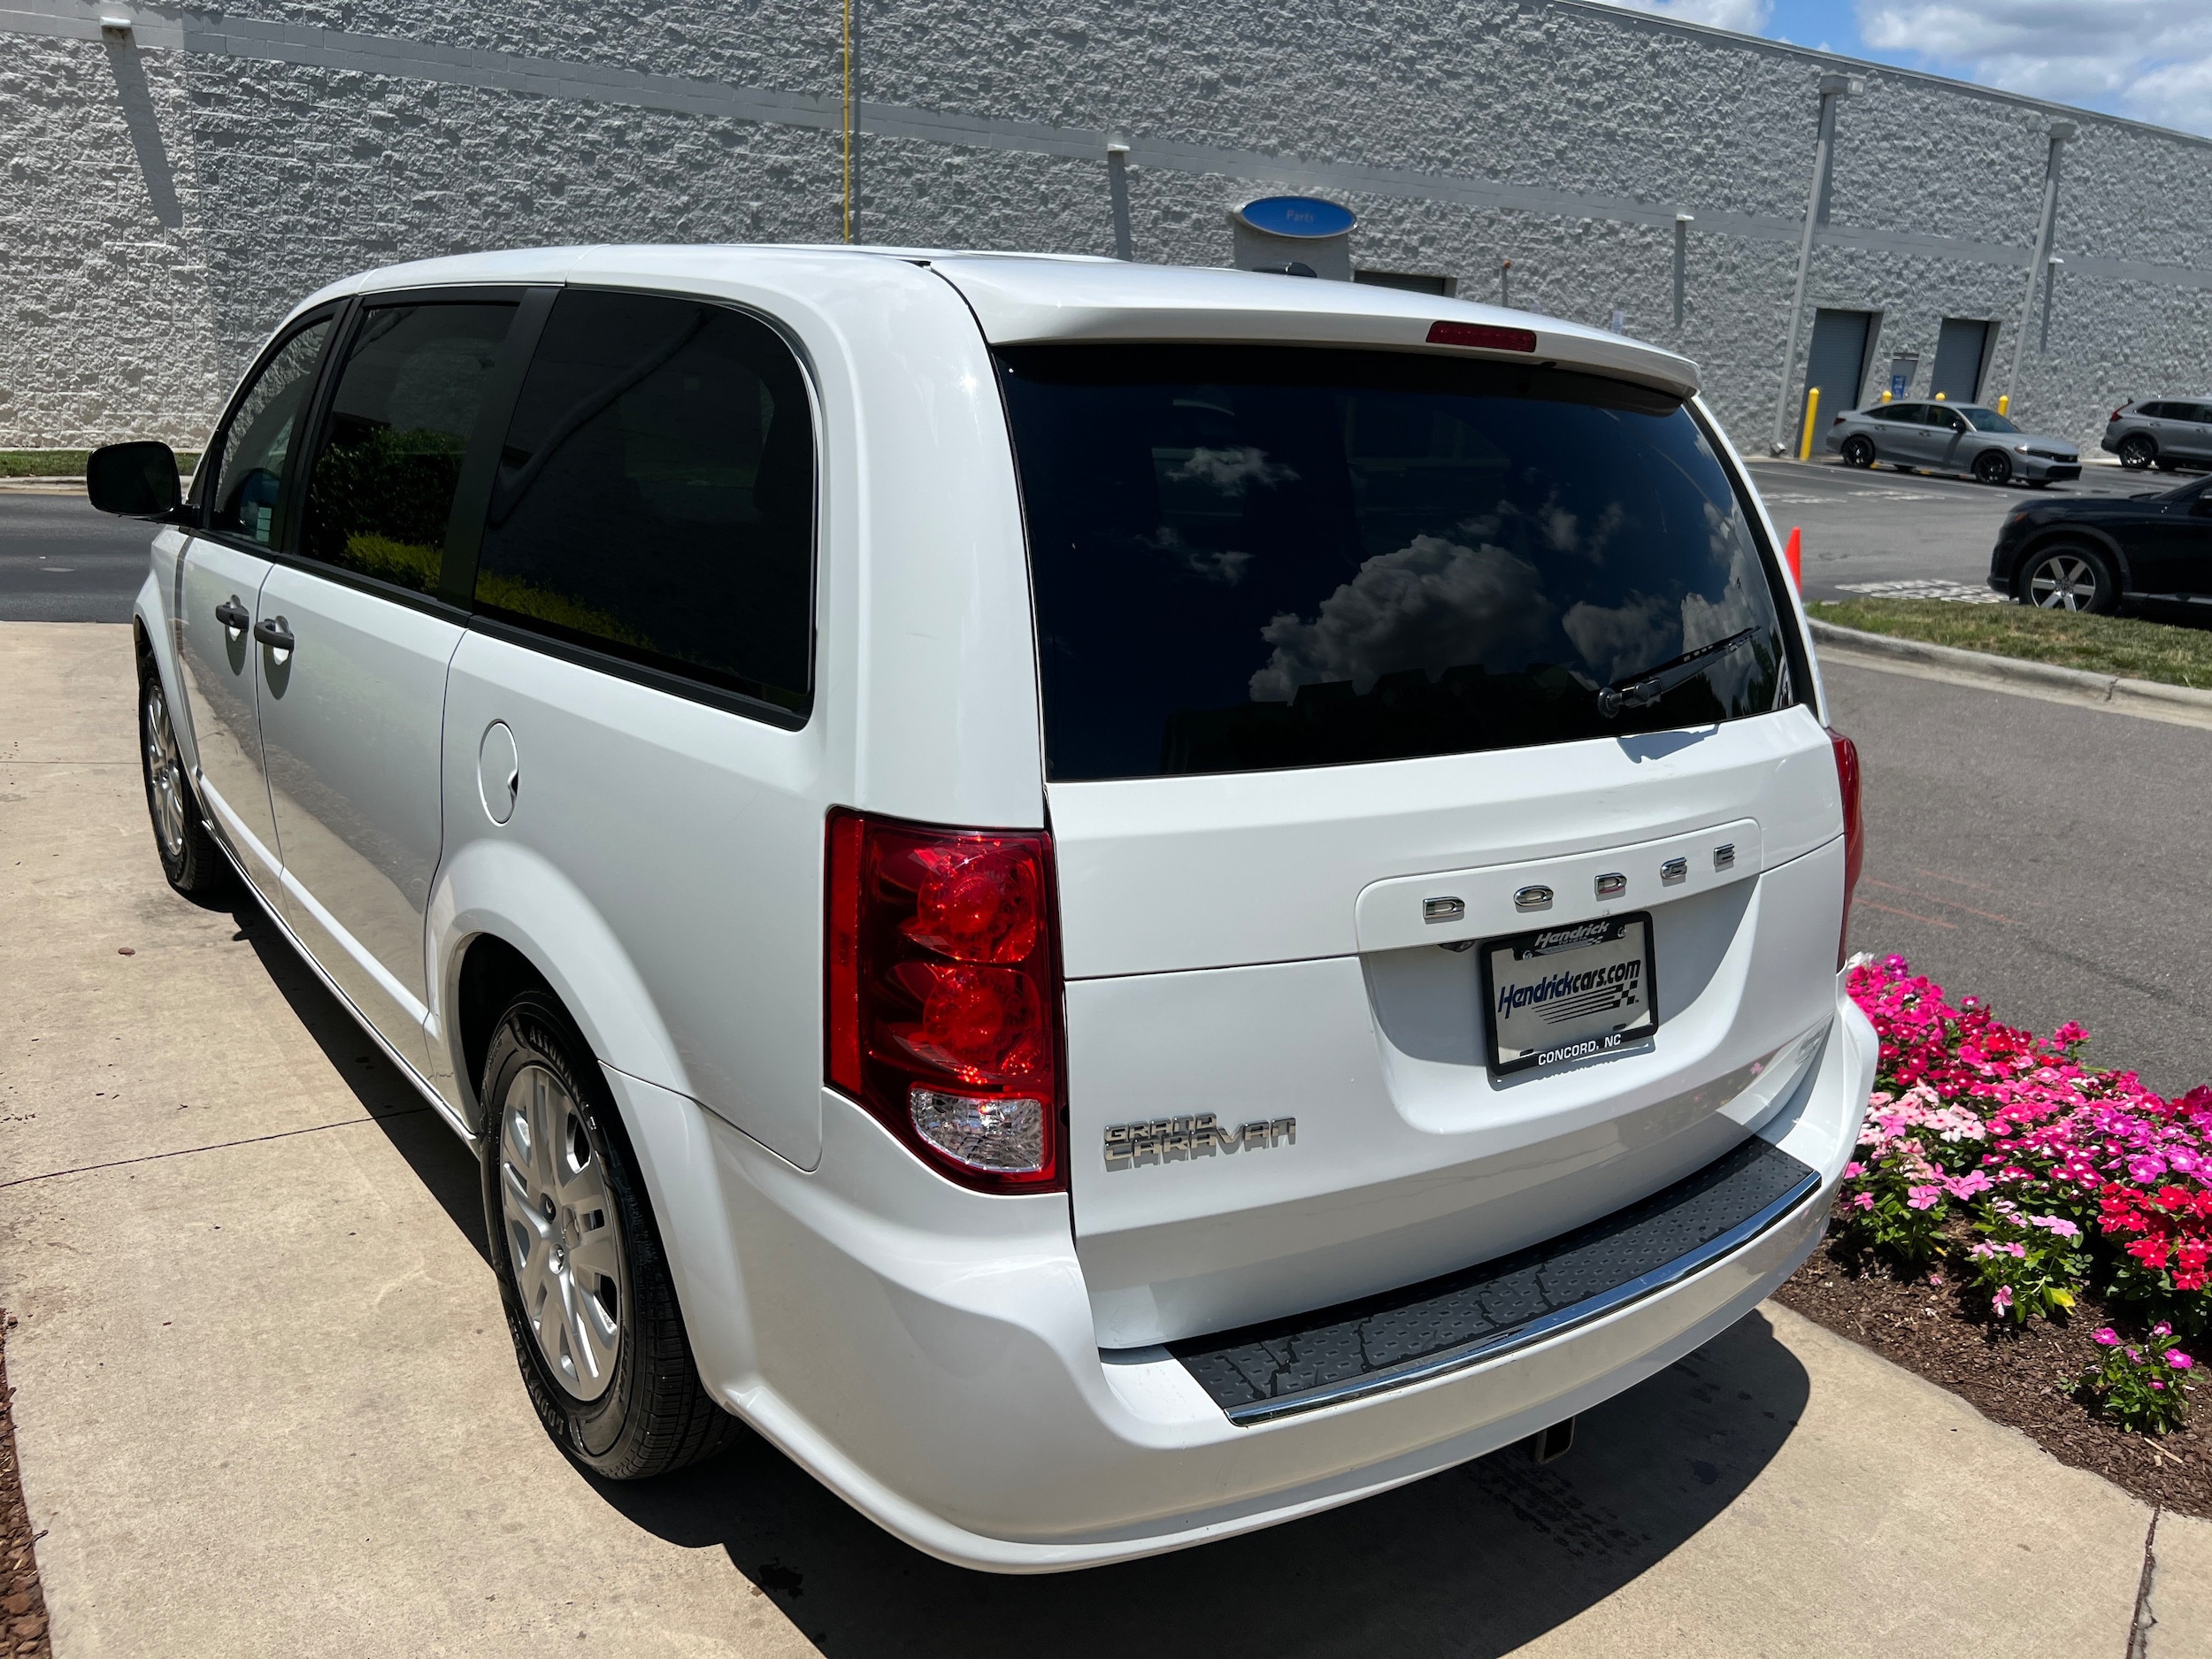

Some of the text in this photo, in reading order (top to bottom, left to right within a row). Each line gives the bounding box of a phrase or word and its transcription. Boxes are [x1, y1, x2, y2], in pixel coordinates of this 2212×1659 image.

[1423, 842, 1735, 919] DODGE
[1534, 921, 1609, 949] Hendrick
[1498, 959, 1641, 1019] Hendrickcars.com
[1538, 1033, 1622, 1066] CONCORD, NC
[1103, 1111, 1217, 1142] GRAND
[1103, 1117, 1296, 1161] CARAVAN
